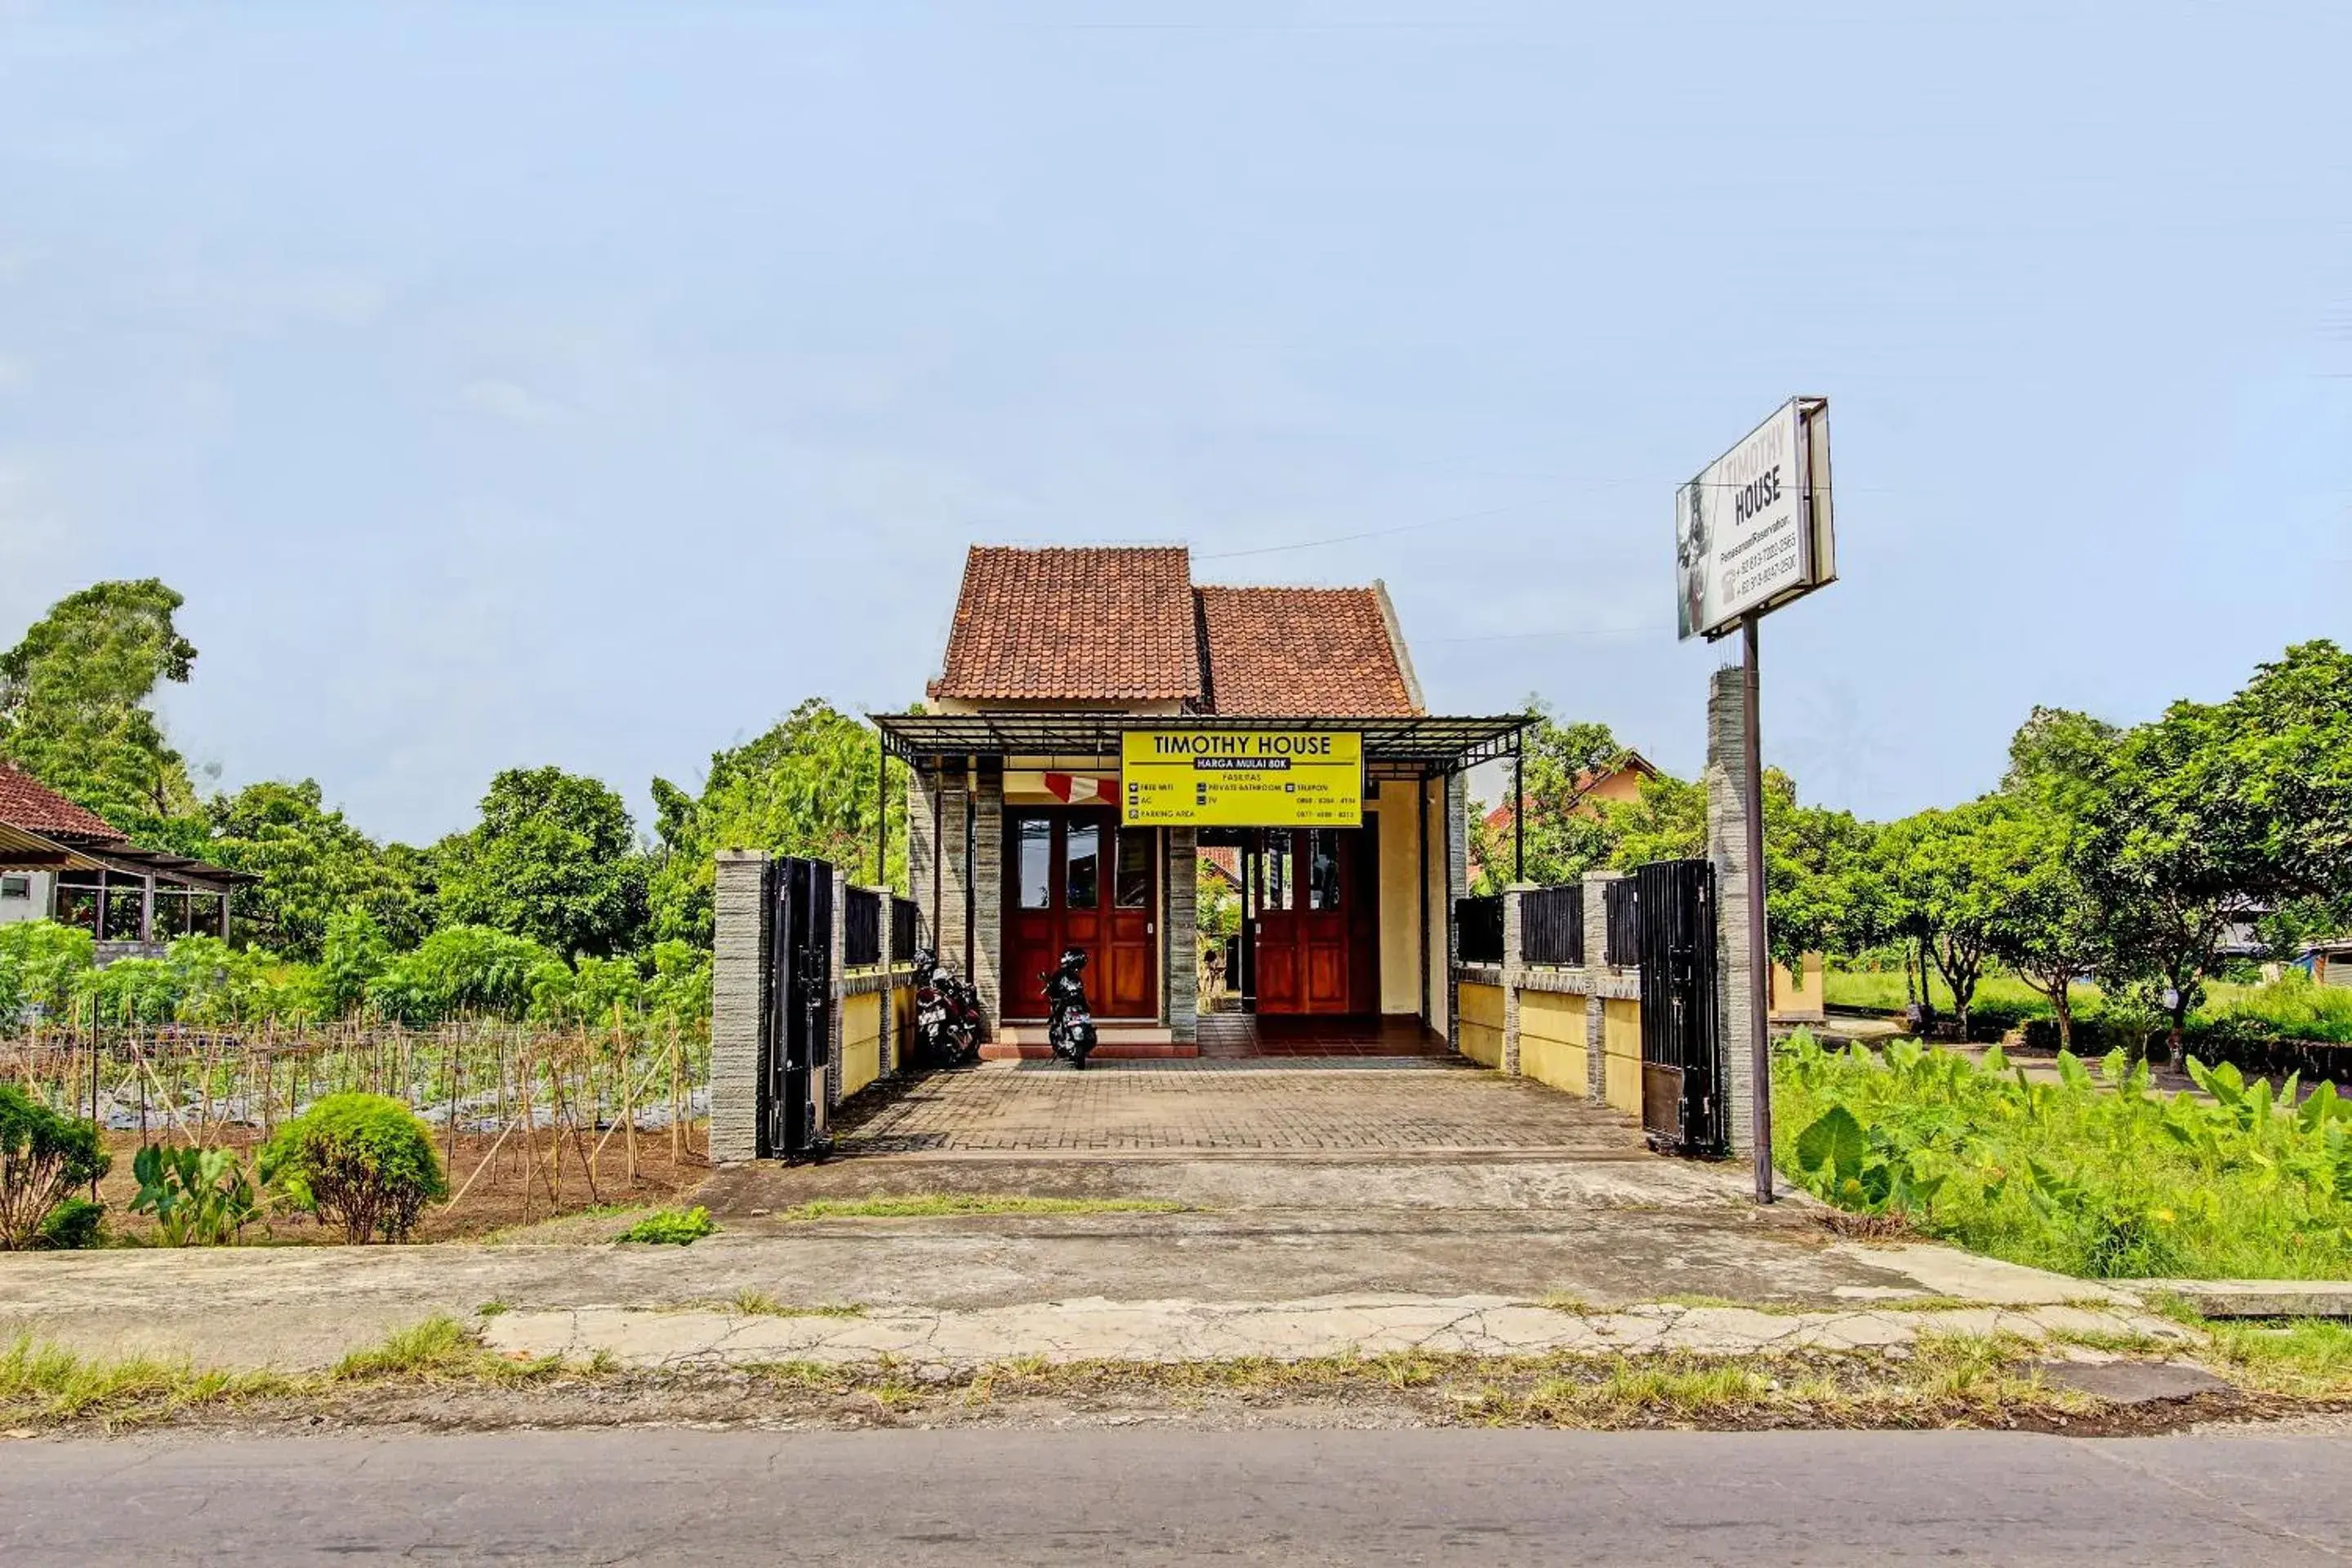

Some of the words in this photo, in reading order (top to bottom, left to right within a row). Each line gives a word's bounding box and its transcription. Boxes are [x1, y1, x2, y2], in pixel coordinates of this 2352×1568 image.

[1724, 421, 1786, 493] TIMOTHY
[1735, 464, 1781, 526] HOUSE
[1153, 736, 1250, 754] TIMOTHY
[1258, 736, 1330, 755] HOUSE
[1197, 759, 1233, 768] HARGA
[1235, 759, 1267, 768] MULAI
